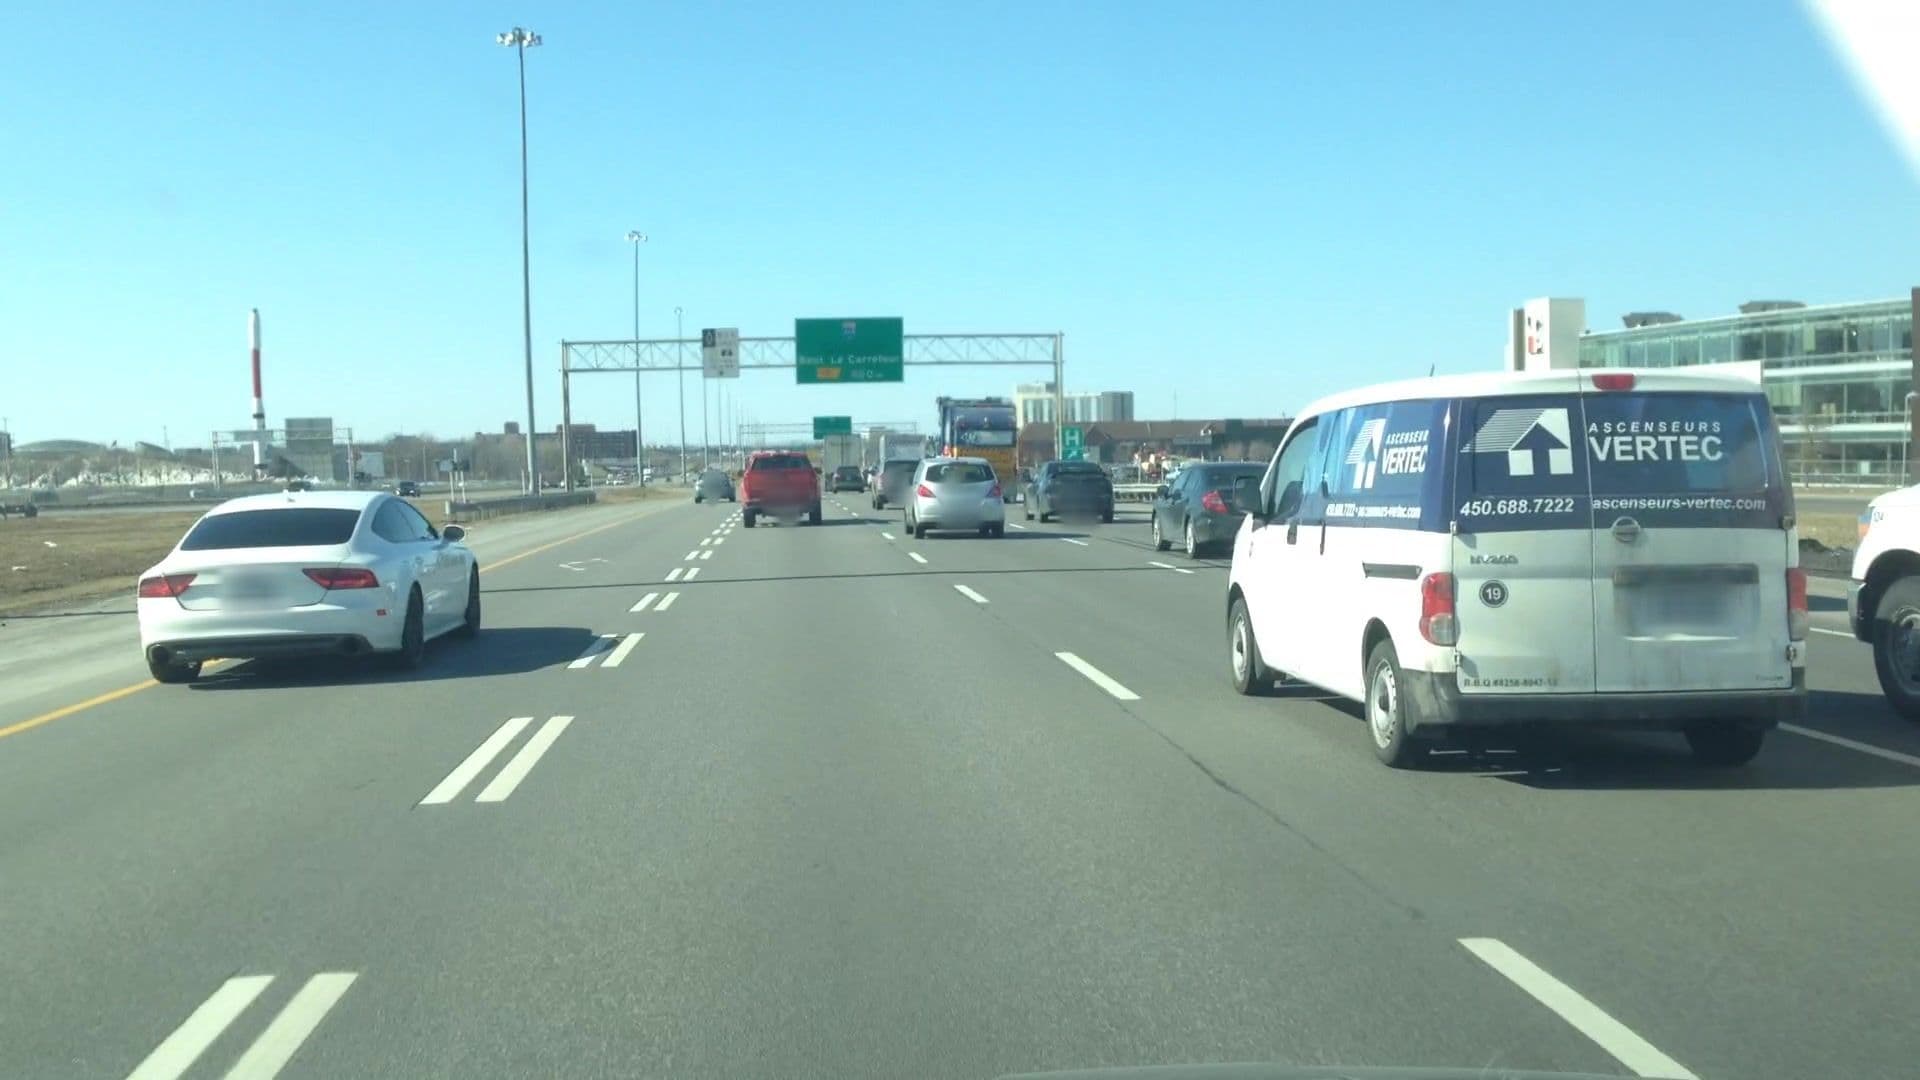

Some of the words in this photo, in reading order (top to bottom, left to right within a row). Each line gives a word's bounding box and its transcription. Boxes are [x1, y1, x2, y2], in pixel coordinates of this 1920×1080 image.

[1588, 421, 1721, 433] ASCENSEURS
[1065, 429, 1079, 446] H
[1589, 435, 1723, 462] VERTEC
[1382, 445, 1428, 474] VERTEC
[1460, 498, 1575, 516] 450.688.7222
[1592, 497, 1766, 512] ascenseurs-vertec.com
[1486, 588, 1501, 600] 19
